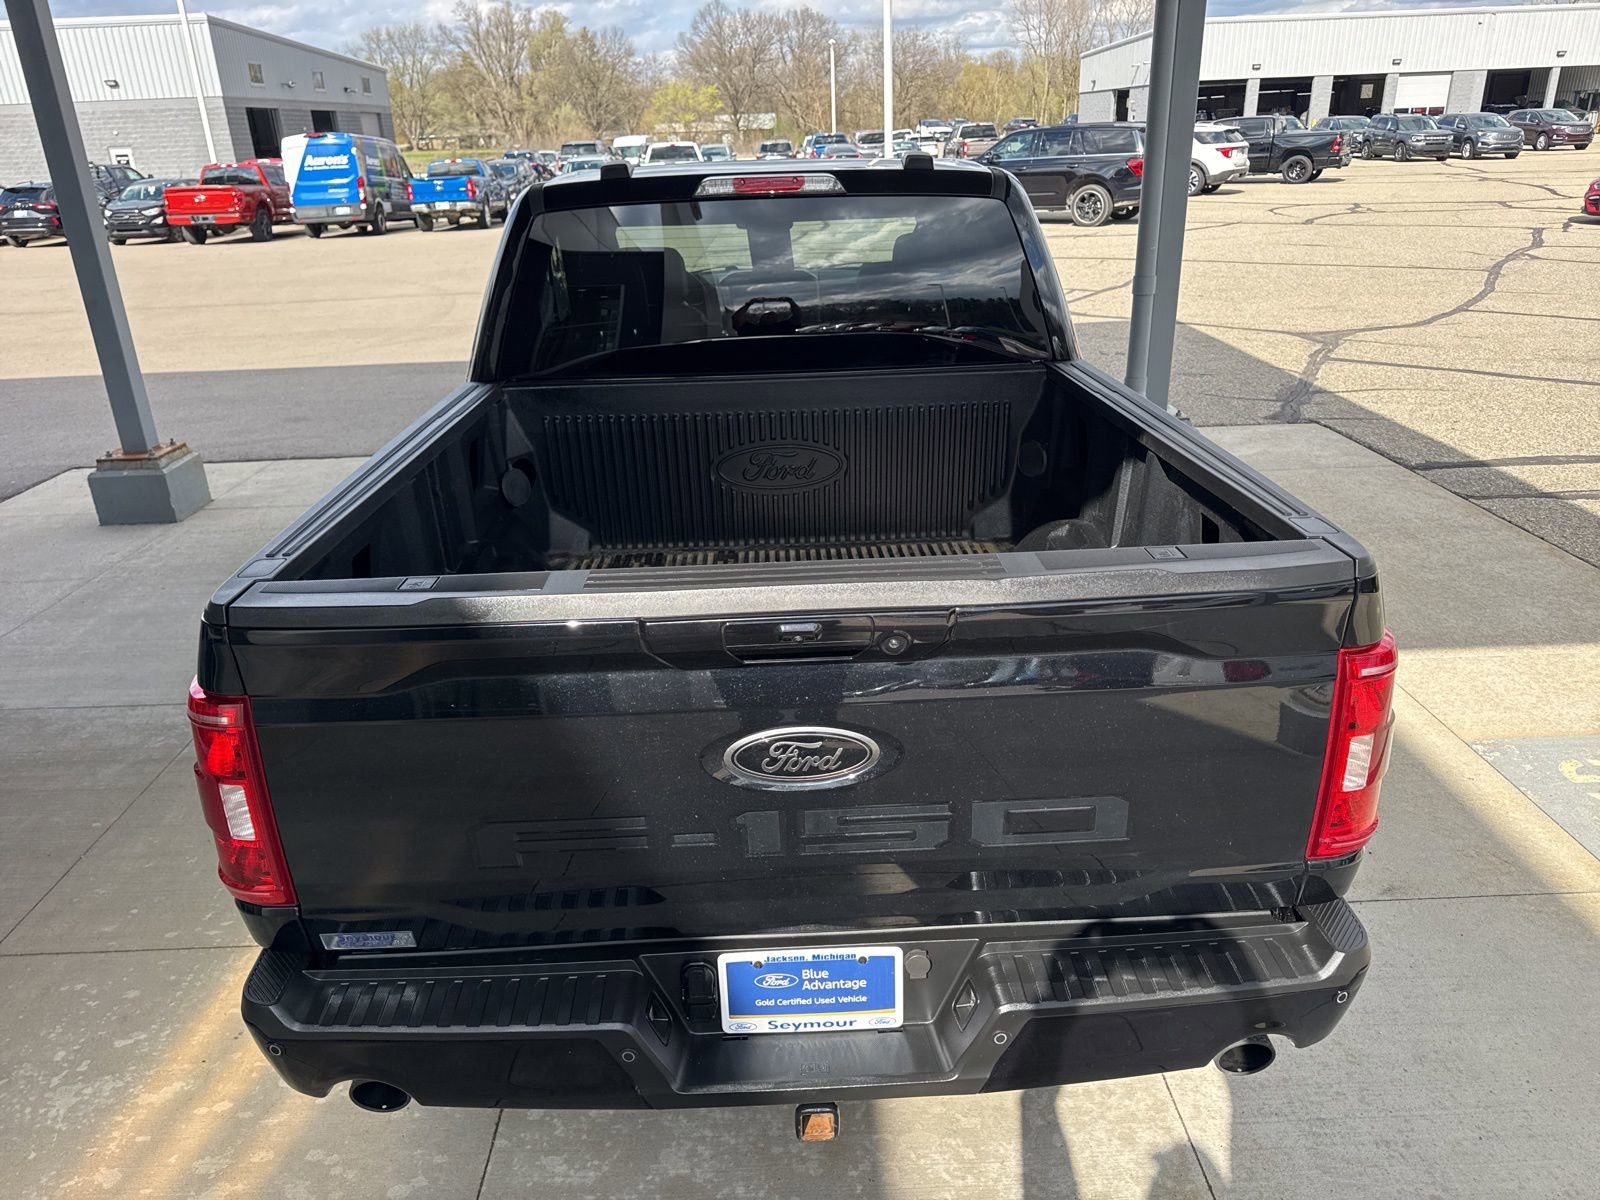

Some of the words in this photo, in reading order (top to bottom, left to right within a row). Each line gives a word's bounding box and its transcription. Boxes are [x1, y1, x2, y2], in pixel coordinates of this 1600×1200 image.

[743, 451, 817, 481] Ford
[761, 741, 842, 773] Ford
[474, 797, 1129, 868] F-150
[812, 953, 857, 962] Michigan
[762, 974, 791, 988] Ford
[802, 969, 829, 980] Blue
[802, 979, 867, 991] Advantage
[755, 999, 775, 1007] Gold
[777, 997, 812, 1006] Certified
[814, 996, 836, 1005] Used
[838, 995, 867, 1004] Vehicle
[768, 1019, 857, 1032] Seymour
